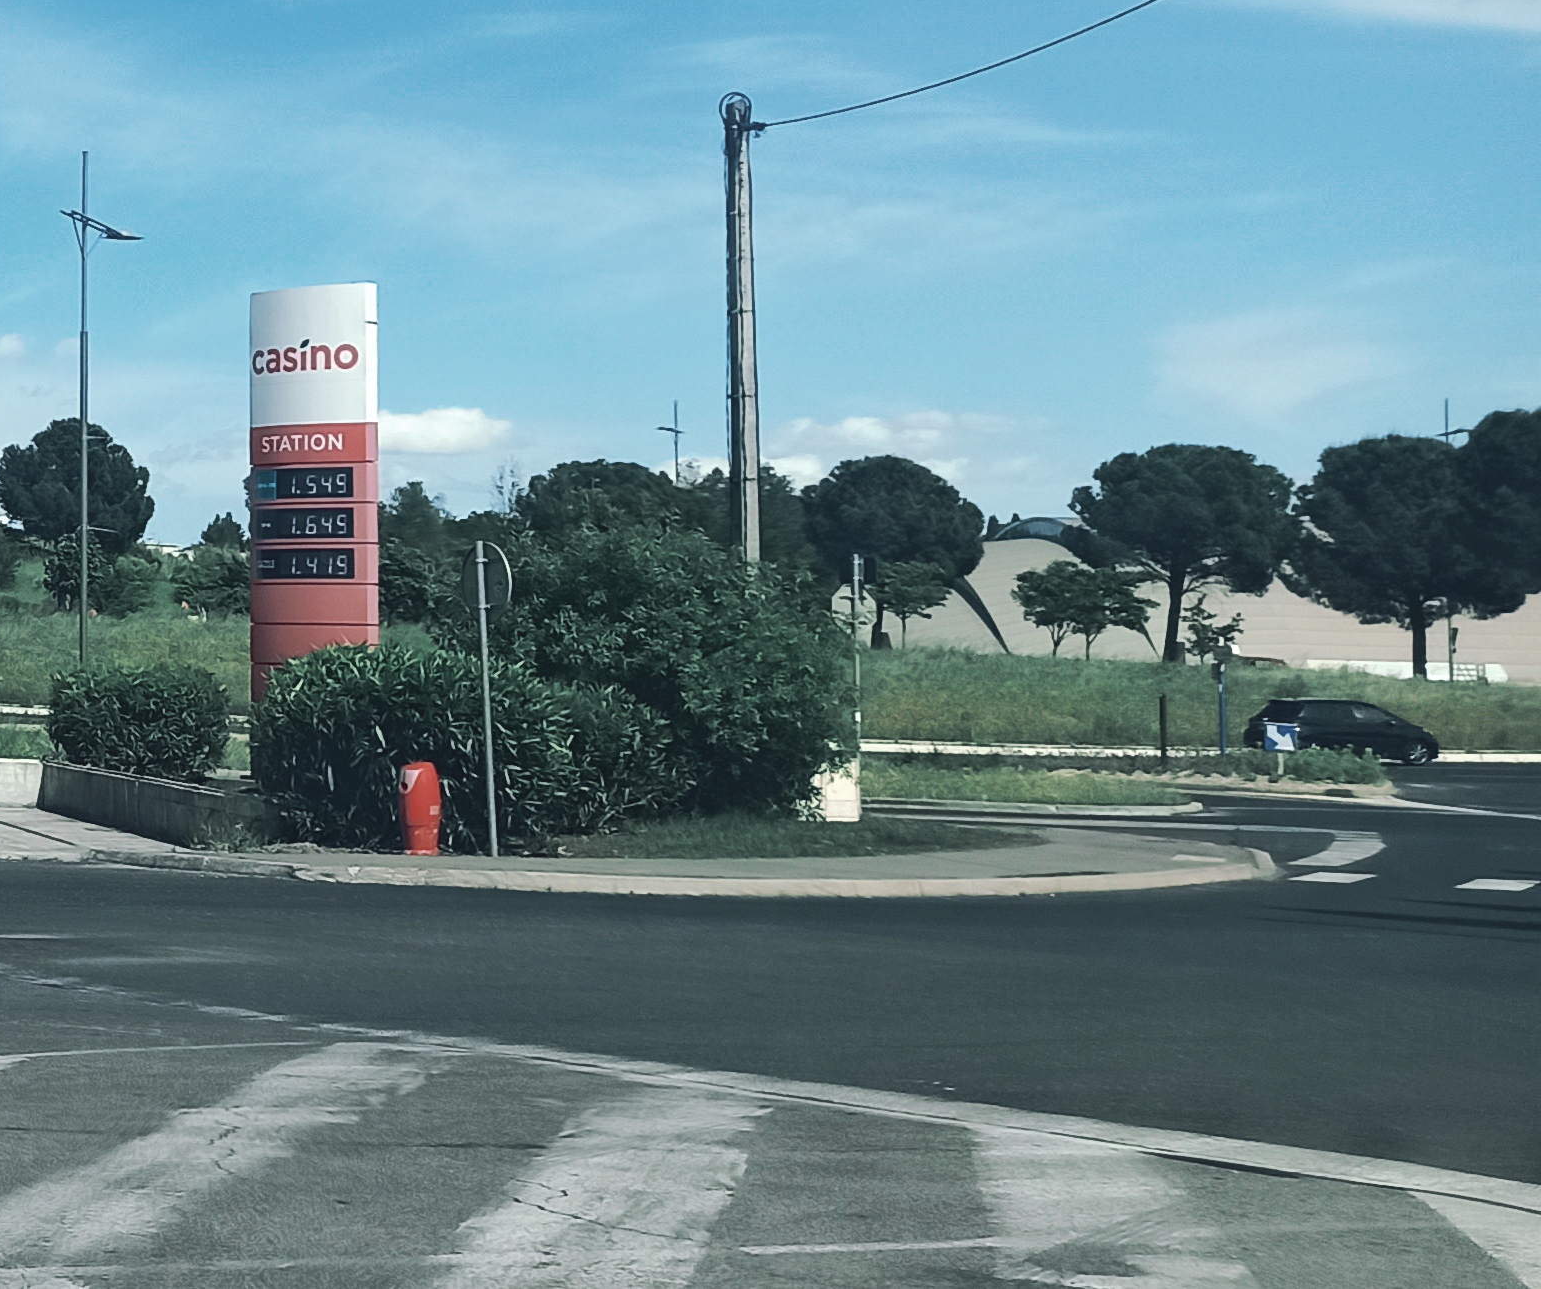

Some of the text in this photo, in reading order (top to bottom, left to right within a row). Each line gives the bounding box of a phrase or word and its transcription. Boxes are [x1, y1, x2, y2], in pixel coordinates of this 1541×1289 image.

[252, 338, 359, 375] casino
[261, 433, 344, 453] STATION
[291, 473, 347, 494] 1.549
[291, 514, 347, 535] 1.649
[291, 555, 348, 575] 1.419
